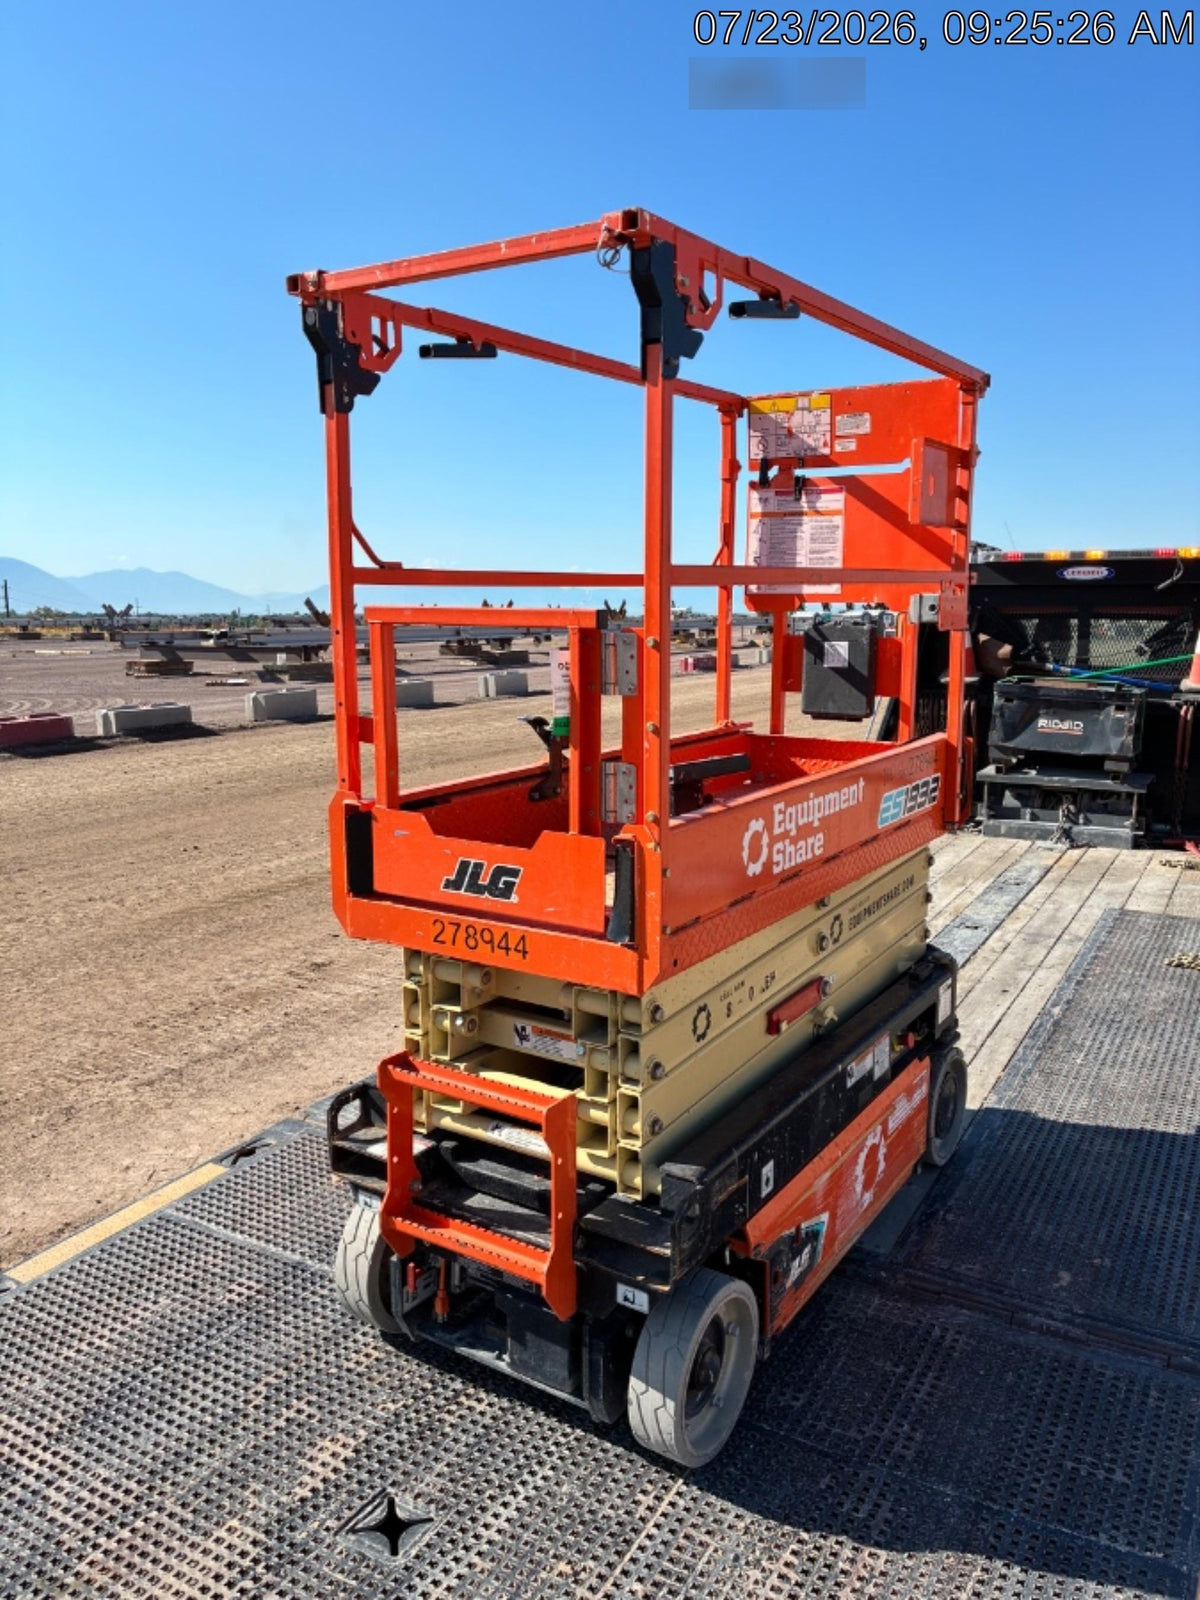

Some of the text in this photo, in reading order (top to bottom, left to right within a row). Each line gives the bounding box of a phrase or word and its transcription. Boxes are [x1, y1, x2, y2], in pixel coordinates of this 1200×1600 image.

[773, 777, 865, 836] Equipment
[772, 832, 824, 875] Share
[441, 857, 523, 903] JLG
[433, 919, 528, 959] 278944
